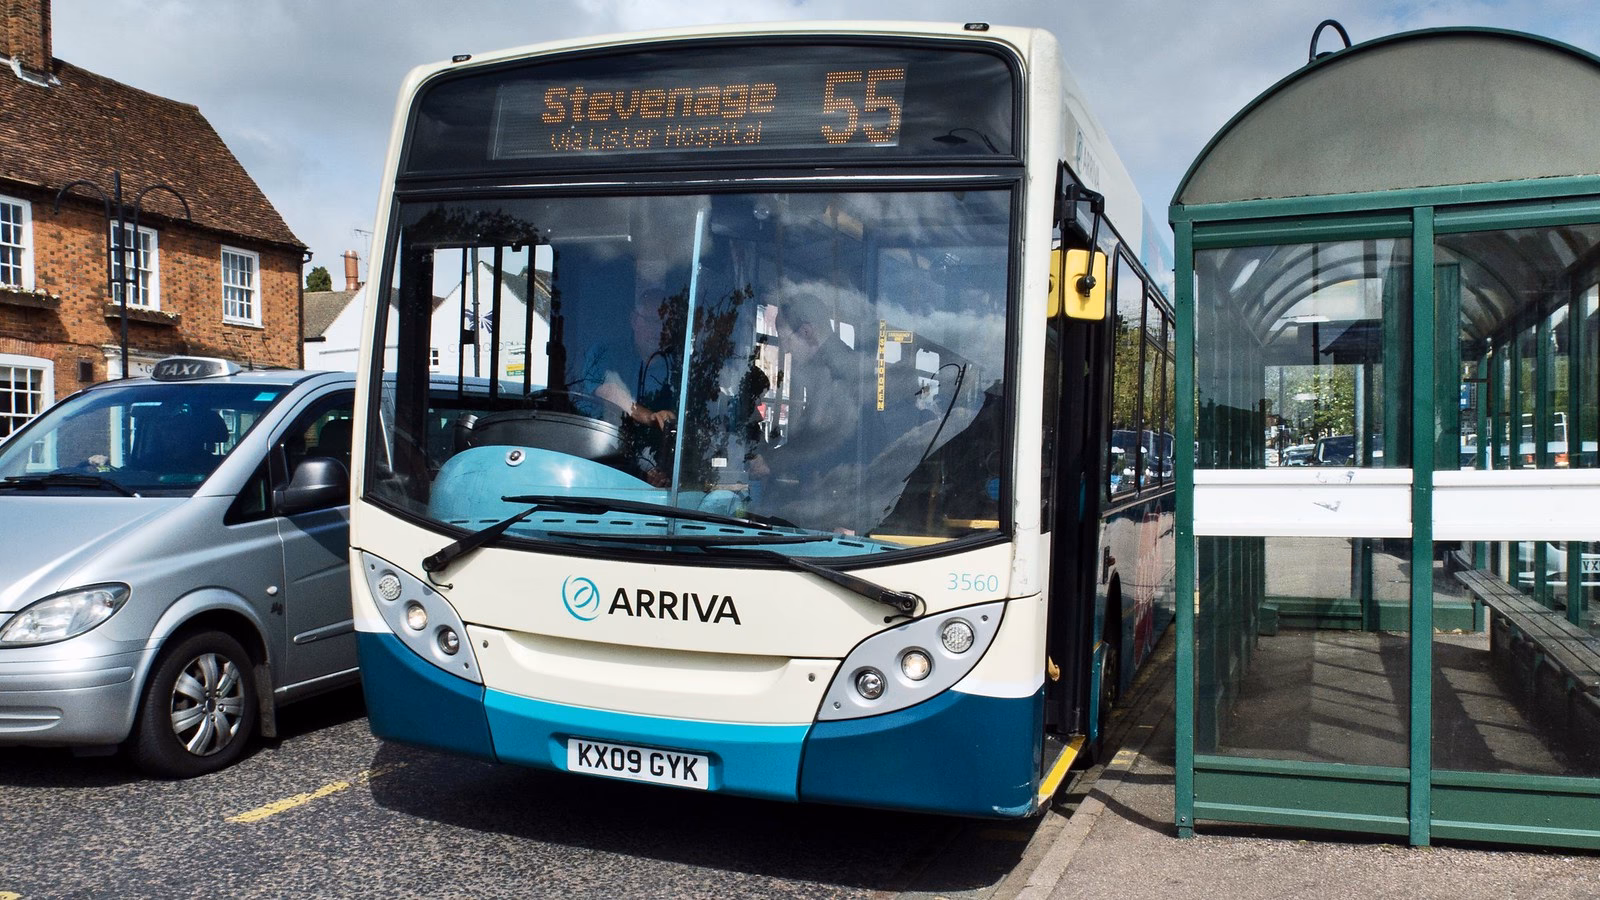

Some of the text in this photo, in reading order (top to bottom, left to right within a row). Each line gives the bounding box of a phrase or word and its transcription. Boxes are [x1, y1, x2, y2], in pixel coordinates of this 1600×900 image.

[542, 82, 777, 124] Stevenage
[821, 68, 905, 144] 55
[551, 121, 763, 151] via Lister Hospital
[161, 363, 201, 376] TAXI
[947, 572, 999, 592] 3560
[1582, 560, 1600, 571] VX
[608, 587, 742, 626] ARRIVA
[578, 742, 698, 782] KX09 GYK
